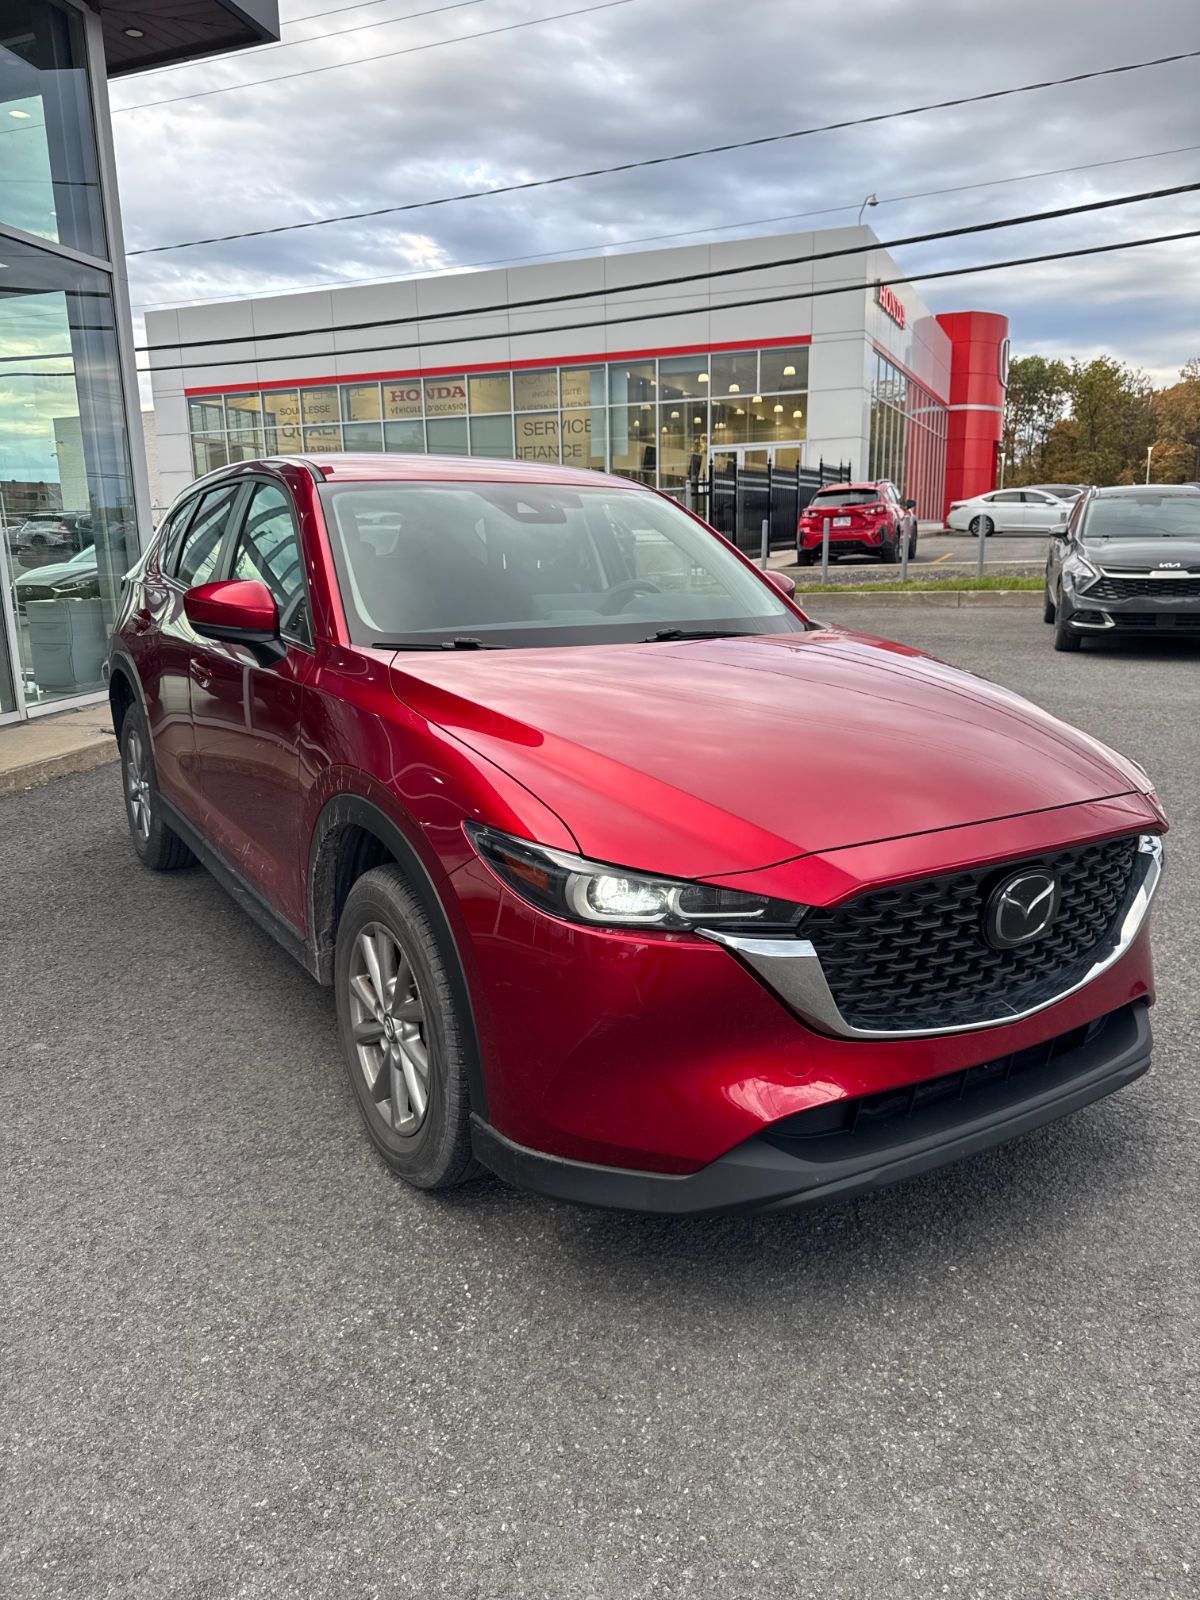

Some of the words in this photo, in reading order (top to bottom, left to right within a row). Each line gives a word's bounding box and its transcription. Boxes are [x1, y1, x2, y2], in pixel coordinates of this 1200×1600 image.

[879, 284, 905, 329] HONDA
[390, 385, 466, 402] HONDA
[279, 405, 331, 416] SOULESSE
[523, 418, 591, 436] SERVICE
